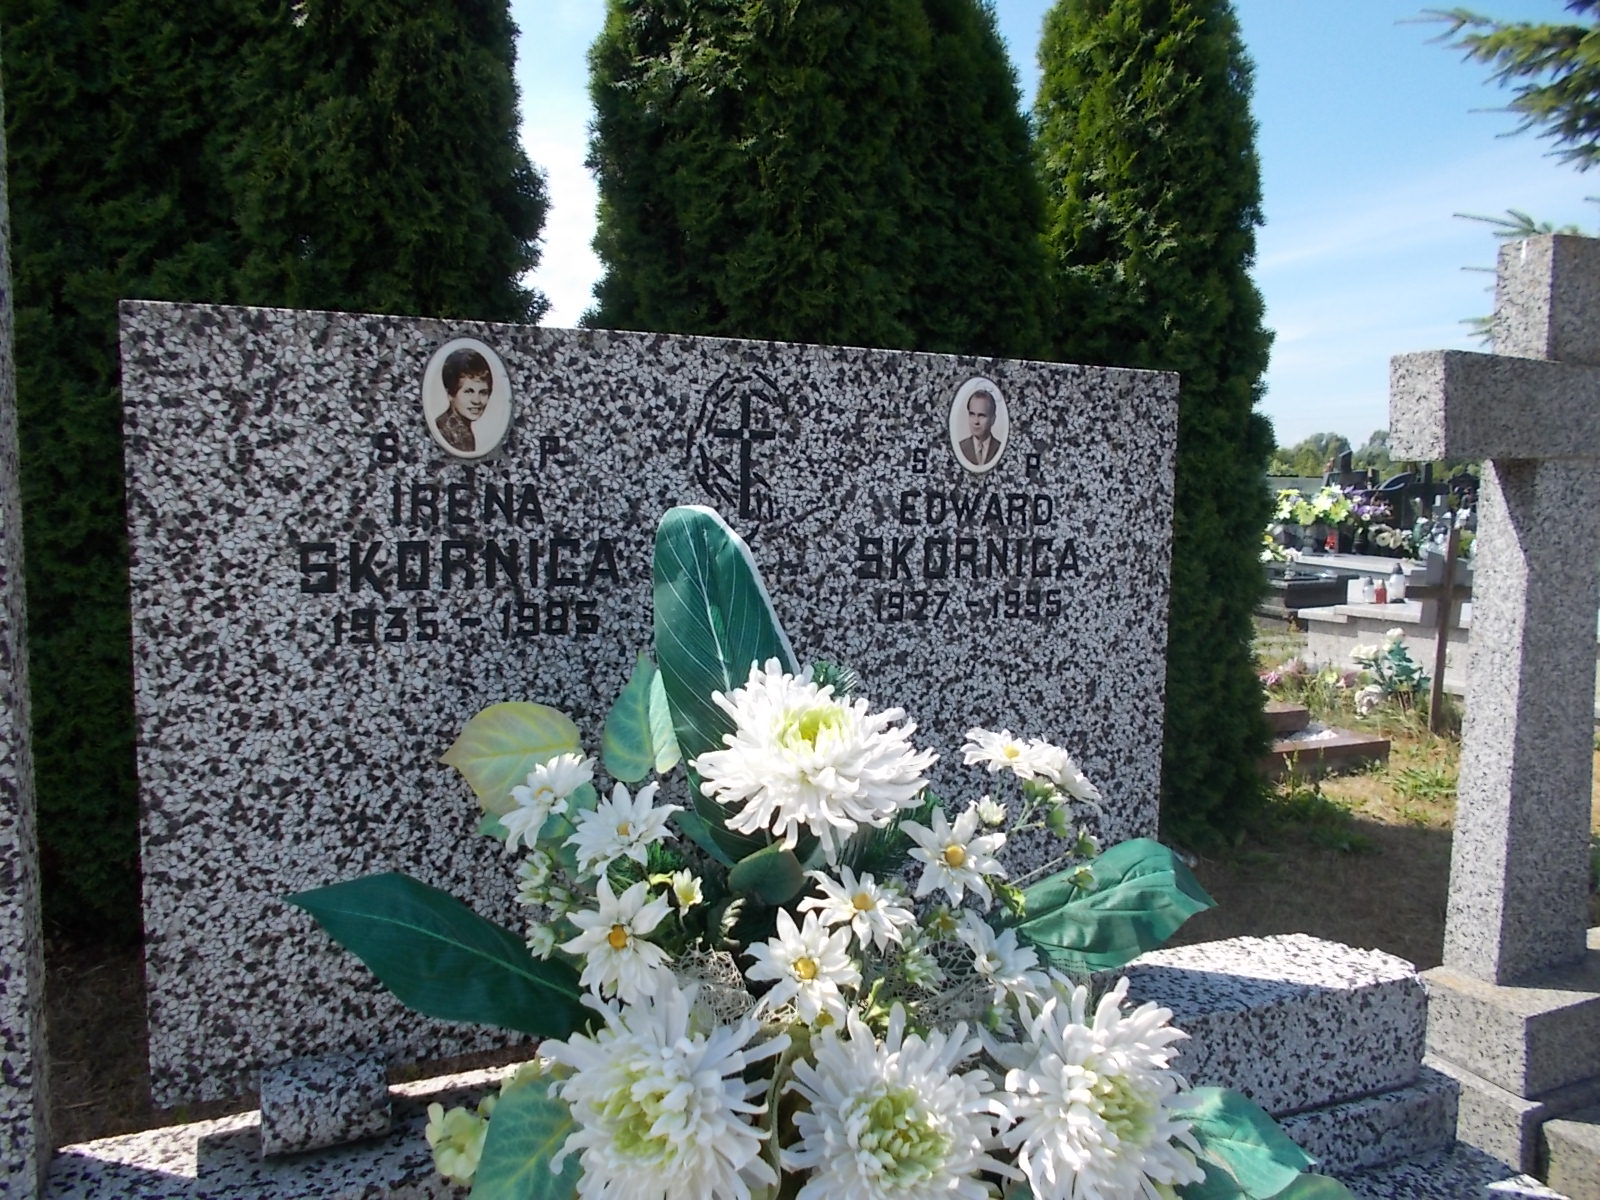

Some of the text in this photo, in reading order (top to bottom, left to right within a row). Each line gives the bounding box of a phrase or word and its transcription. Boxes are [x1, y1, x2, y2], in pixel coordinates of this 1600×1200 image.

[391, 482, 546, 527] IRENA
[899, 489, 1054, 527] EDWARD
[332, 605, 439, 646] 1935
[500, 600, 600, 641] 1985
[876, 590, 950, 623] 1927
[991, 588, 1062, 619] 1995
